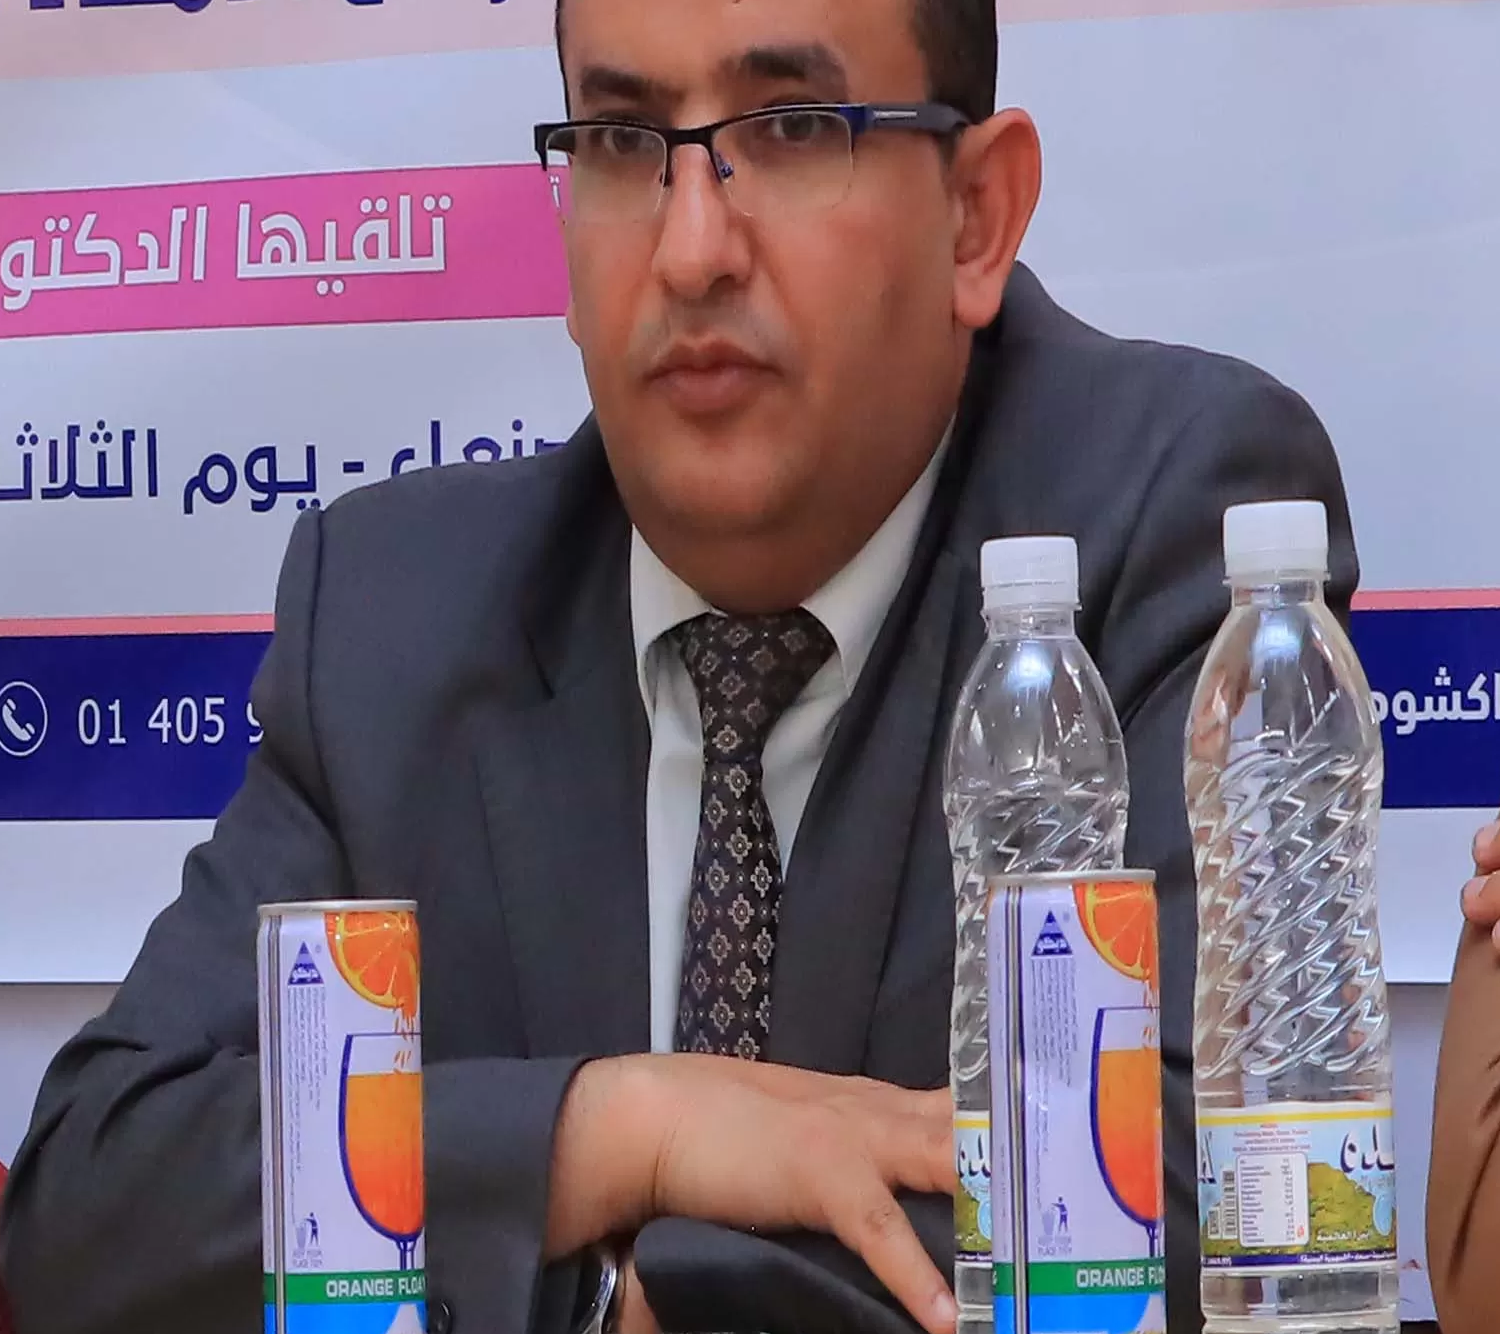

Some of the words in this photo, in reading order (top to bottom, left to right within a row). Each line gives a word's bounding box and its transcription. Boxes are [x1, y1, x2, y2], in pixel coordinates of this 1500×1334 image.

[236, 192, 454, 297] تلقيها
[181, 446, 325, 514] يوم
[76, 698, 128, 747] 01
[147, 696, 227, 745] 405
[325, 1277, 394, 1298] ORANGE
[1075, 1267, 1145, 1288] ORANGE
